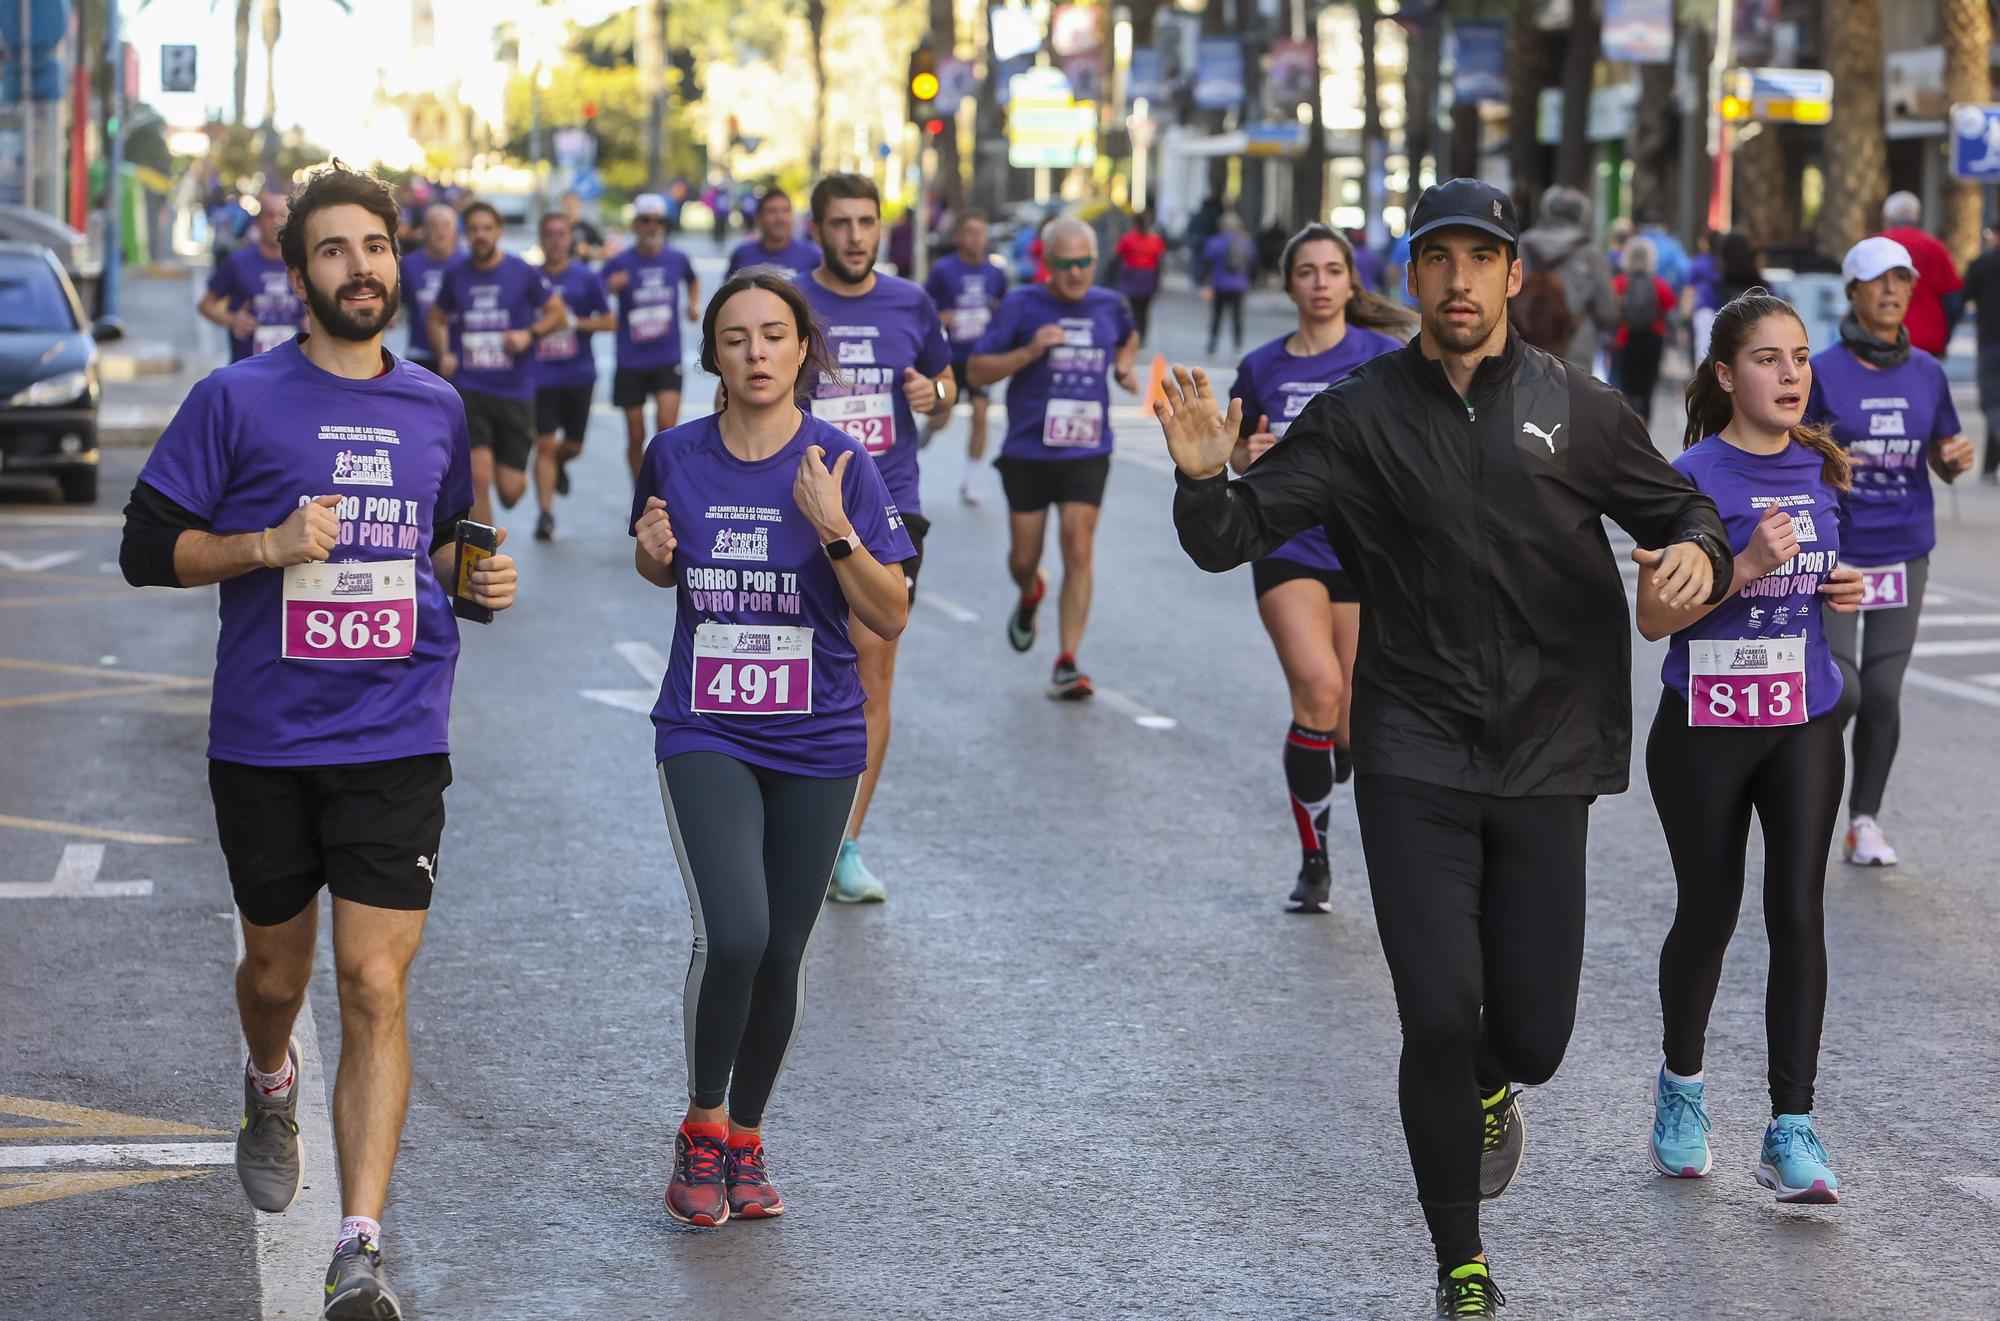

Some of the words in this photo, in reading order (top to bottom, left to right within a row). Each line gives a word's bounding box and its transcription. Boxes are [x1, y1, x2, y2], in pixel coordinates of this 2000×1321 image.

[838, 419, 884, 445] 82
[351, 455, 390, 465] CARRERA
[362, 463, 374, 471] DE
[376, 464, 392, 472] LAS
[350, 471, 392, 480] CIUDADES
[365, 496, 401, 522] POR
[405, 500, 418, 525] TI
[756, 507, 780, 515] CIUDADES
[359, 521, 394, 547] POR
[731, 533, 768, 542] CARRERA
[752, 541, 768, 549] LAS
[728, 547, 767, 555] CIUDADES
[1798, 552, 1824, 573] POR
[686, 567, 737, 590] CORRO
[742, 570, 777, 592] POR
[781, 572, 797, 594] TI
[1740, 576, 1790, 598] CORRO
[1788, 574, 1818, 595] POR
[1861, 573, 1897, 604] 54
[689, 590, 734, 613] ORRO
[739, 591, 772, 612] POR
[305, 609, 402, 649] 863
[707, 663, 790, 705] 491
[1709, 681, 1792, 718] 813
